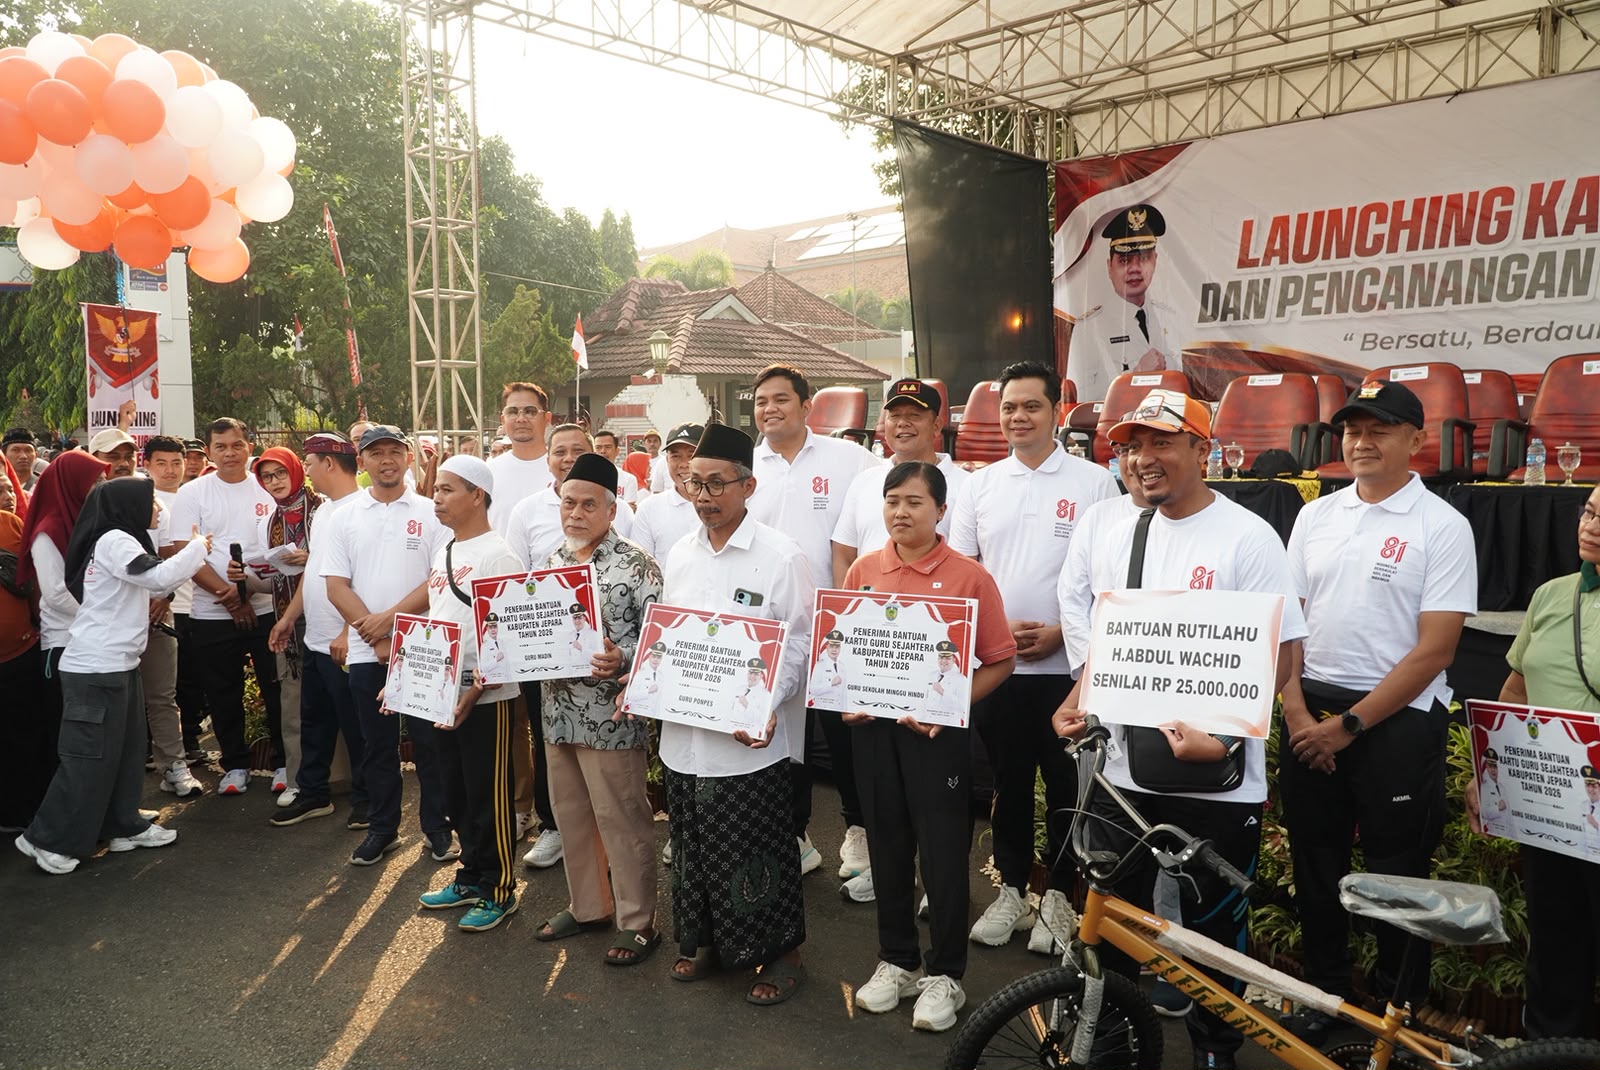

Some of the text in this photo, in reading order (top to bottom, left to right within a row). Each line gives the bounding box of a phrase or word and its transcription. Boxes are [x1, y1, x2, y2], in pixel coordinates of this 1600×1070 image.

[1237, 186, 1515, 269] LAUNCHING
[1197, 247, 1596, 324] DAN PENCANANGAN
[1360, 329, 1473, 351] Bersatu,
[91, 410, 156, 427] LAUNING
[812, 476, 829, 496] 81
[255, 503, 268, 516] 81
[1056, 499, 1076, 522] 81
[407, 520, 422, 537] 81
[1380, 537, 1408, 564] 81
[1190, 566, 1215, 590] 81
[504, 600, 561, 614] PENERIMA BANTUAN
[499, 609, 569, 623] KARTU GURU SEJAHTERA
[507, 618, 563, 631] KABUPATEN JEPARA
[518, 630, 537, 638] TAHUN
[853, 627, 927, 641] PENERIMA BANTUAN
[1106, 621, 1258, 642] BANTUAN RUTILAHU
[675, 640, 741, 657] PENERIMA BANTUAN
[844, 636, 935, 653] KARTU GURU SEJAHTERA
[666, 648, 746, 668] KARTU GURU SEJAHTERA
[852, 647, 924, 662] KABUPATEN JEPARA
[1112, 648, 1241, 669] H.ABDUL WACHID
[671, 659, 736, 676] KABUPATEN JEPARA
[865, 658, 910, 671] TAHUN 2026
[682, 669, 722, 684] TAHUN 2026
[862, 686, 885, 694] SEKOLAH
[886, 688, 907, 697] MINGGU
[908, 691, 924, 699] HINDU
[1092, 673, 1259, 700] SENILAI RP 25.000.000
[678, 695, 714, 707] GURU PONPES
[1504, 745, 1570, 765] PENERIMA BANTUAN
[1499, 755, 1580, 779] KARTU GURU SEJAHTERA
[1508, 768, 1573, 789] KABUPATEN JEPARA
[1521, 781, 1562, 798] TAHUN 2026
[1511, 809, 1524, 818] GURU
[1524, 812, 1545, 823] SEKOLAH
[1545, 818, 1565, 828] MINGGU
